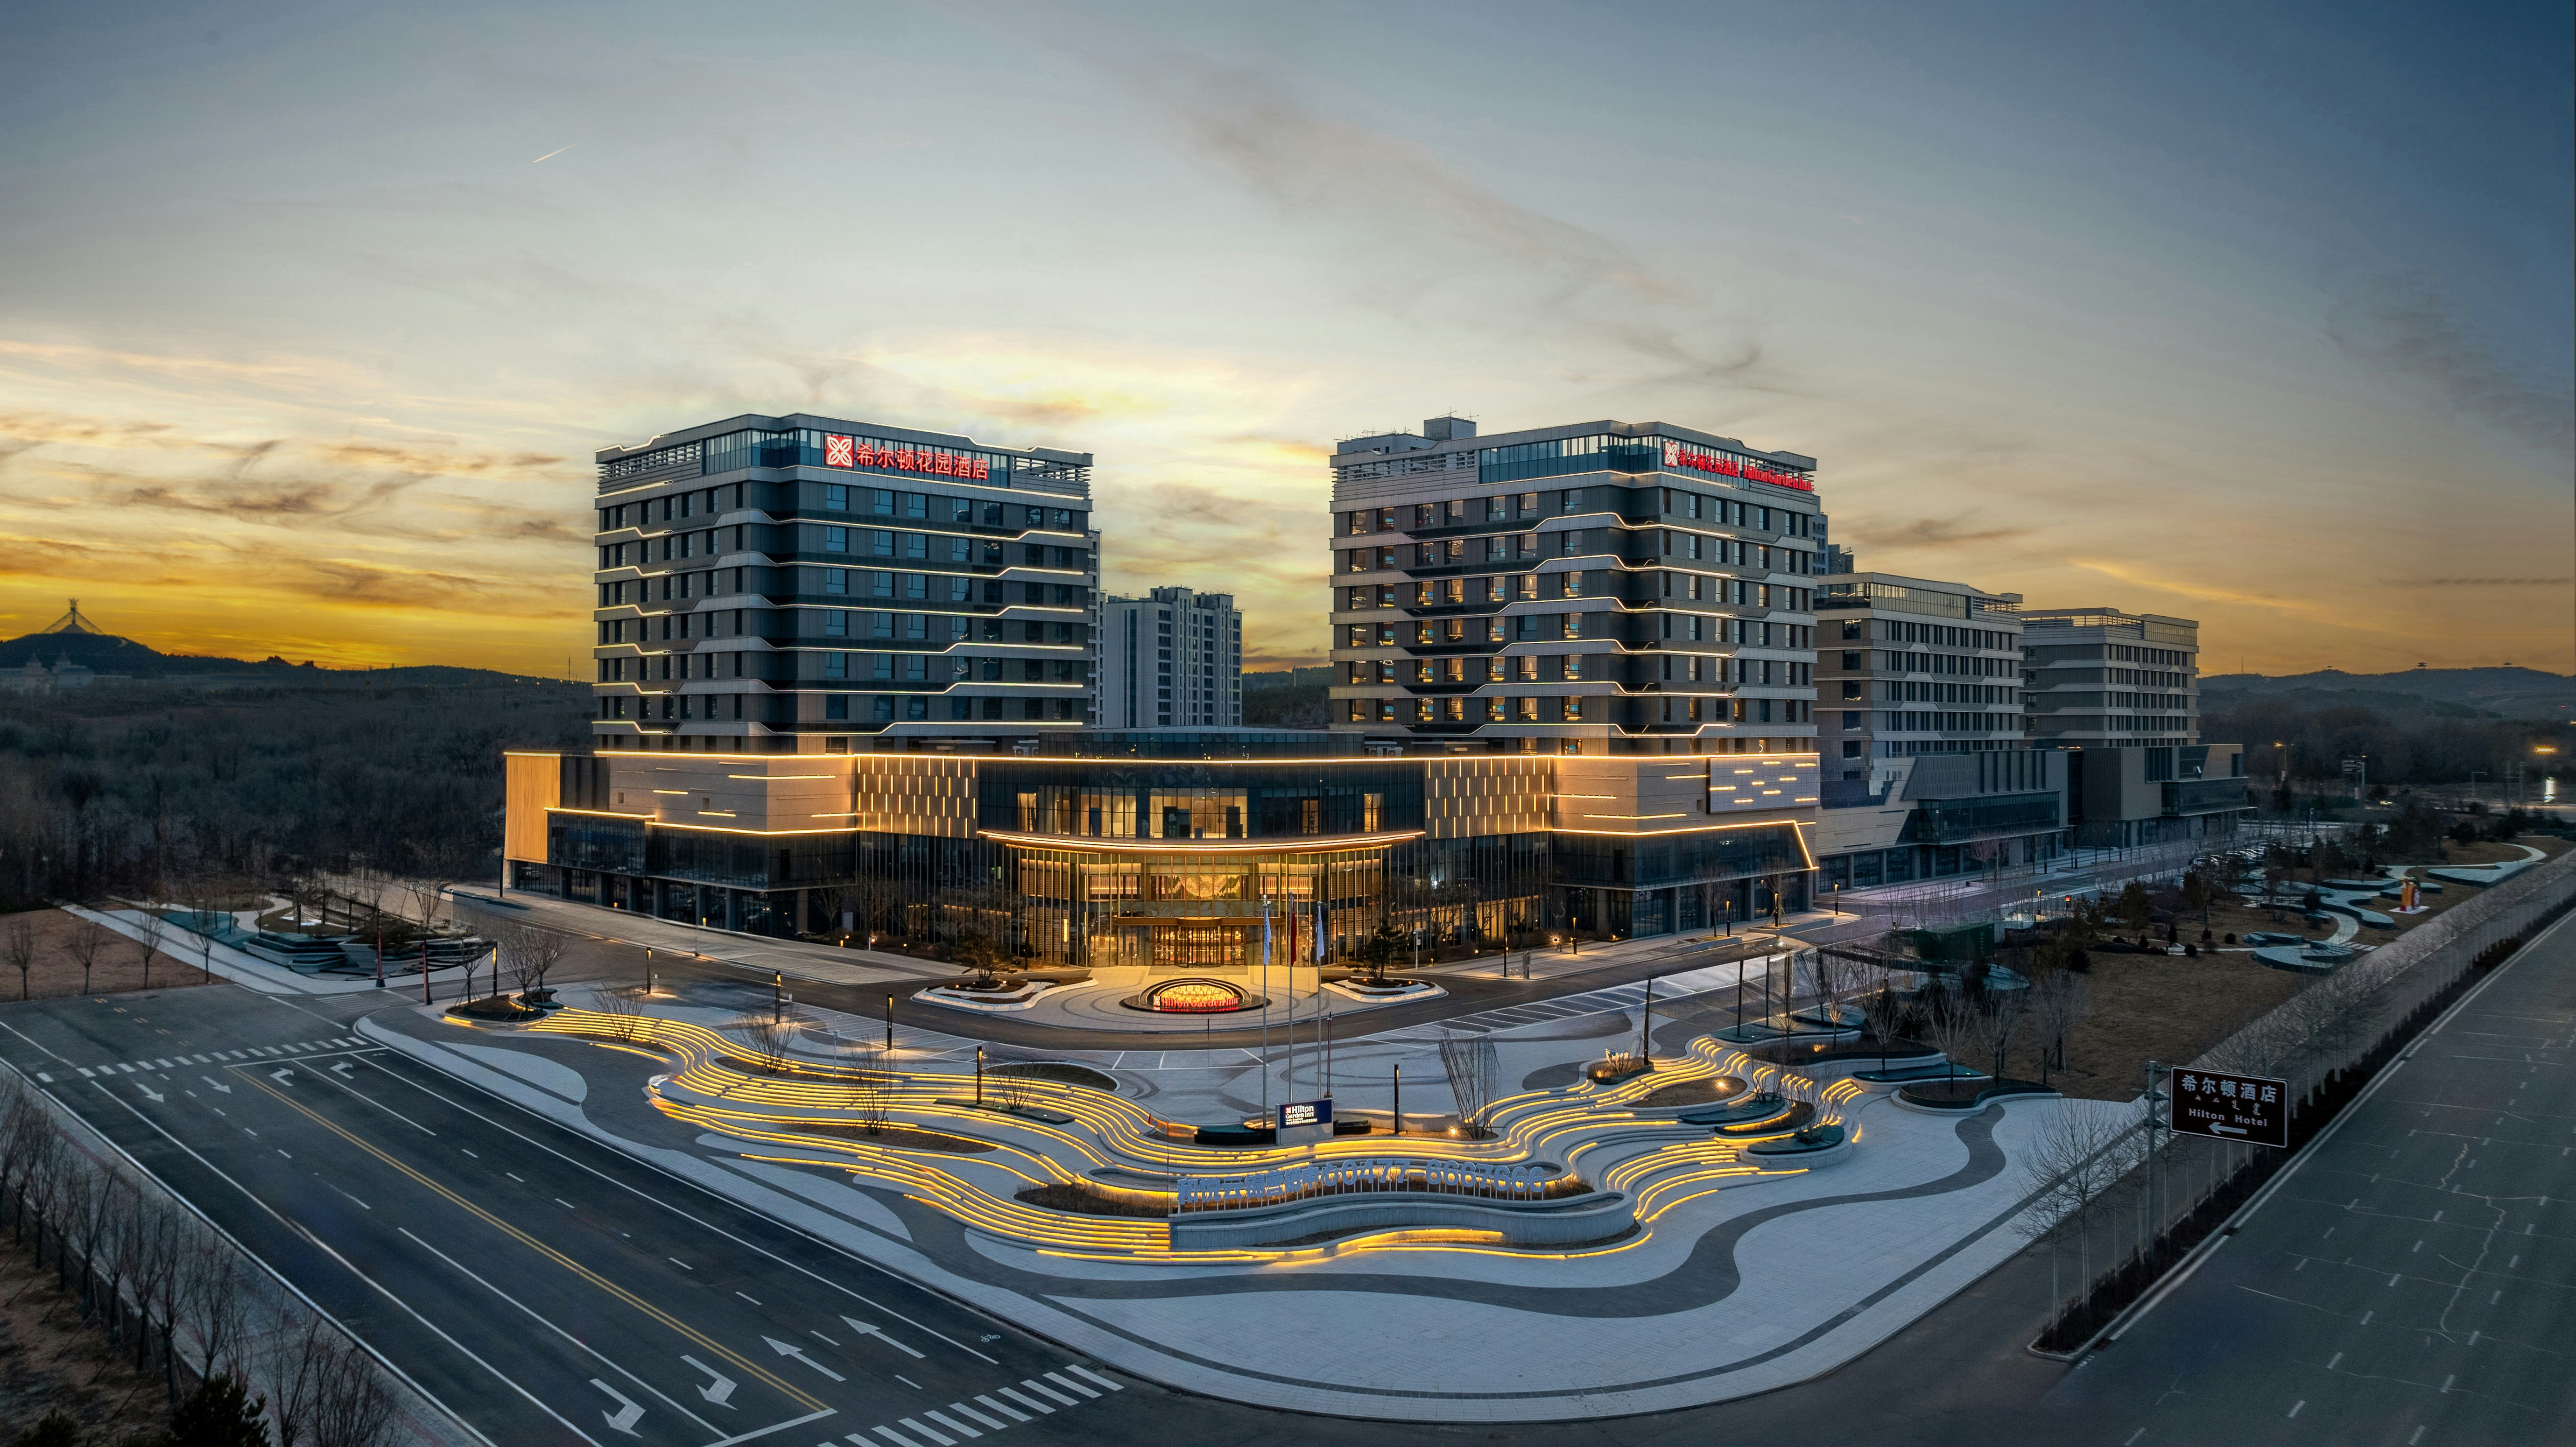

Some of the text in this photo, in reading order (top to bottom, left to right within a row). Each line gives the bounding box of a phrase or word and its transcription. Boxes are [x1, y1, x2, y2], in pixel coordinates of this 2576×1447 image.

[856, 443, 988, 480] 希尔顿花园酒店
[1678, 449, 1740, 478] 希尔顿花园酒店
[1744, 464, 1812, 491] Hilton Garden Inn
[1162, 997, 1238, 1008] Hilton Garden Inn
[2182, 1075, 2277, 1103] 希尔顿酒店
[1292, 1105, 1314, 1114] Hilton
[2189, 1108, 2267, 1126] Hilton Hotel
